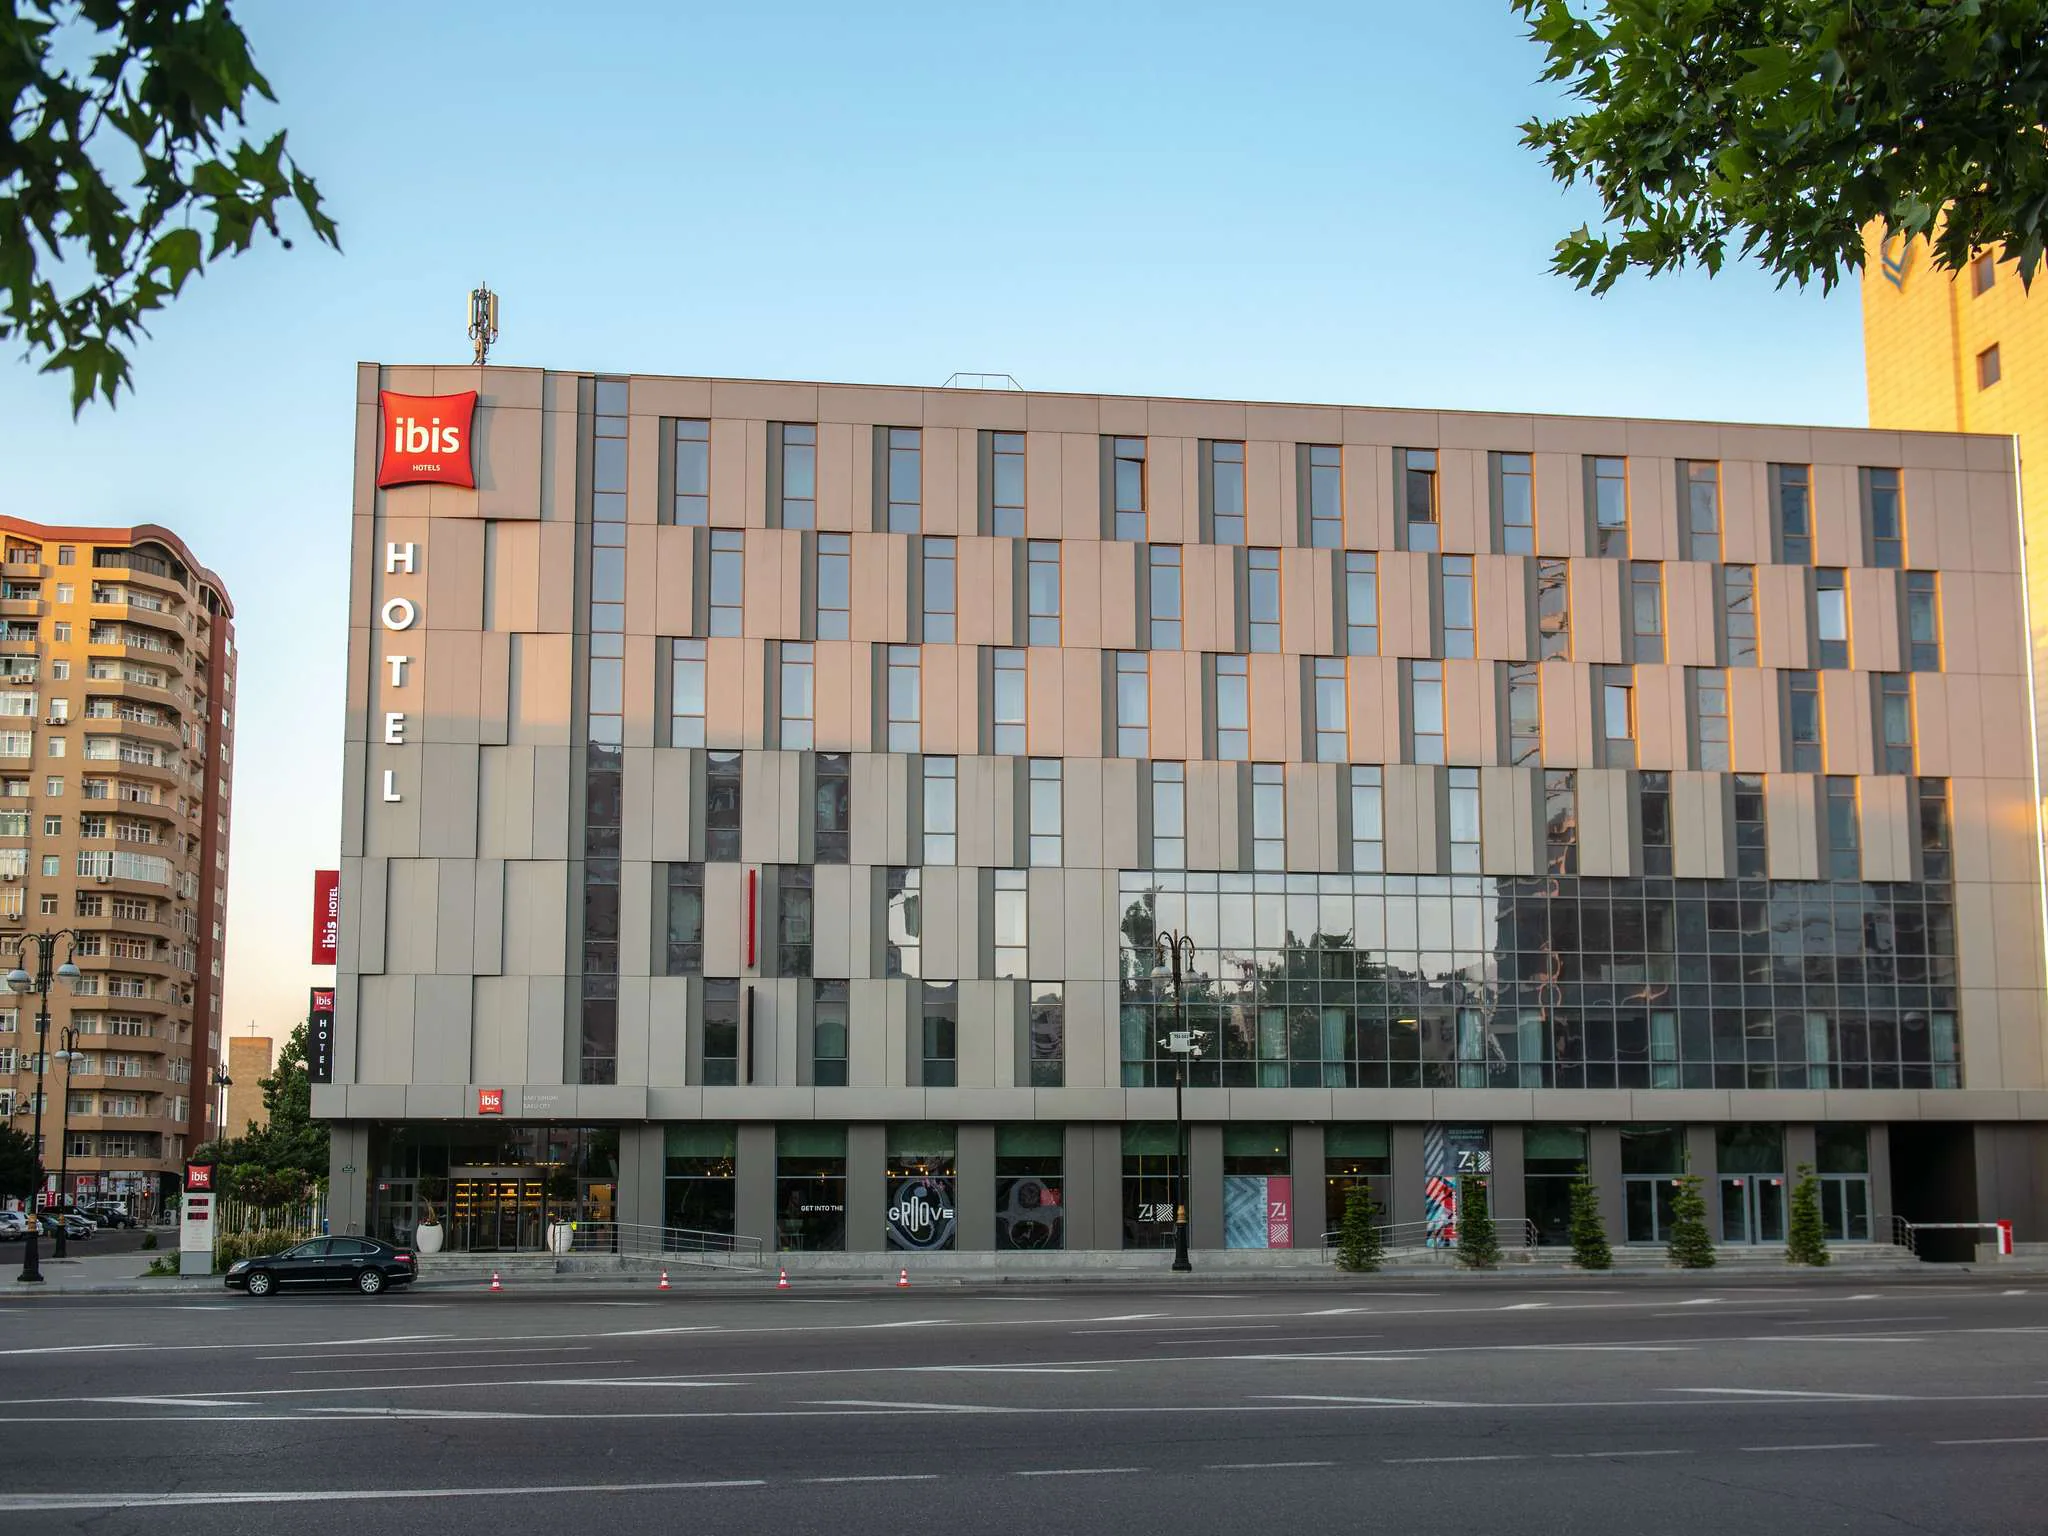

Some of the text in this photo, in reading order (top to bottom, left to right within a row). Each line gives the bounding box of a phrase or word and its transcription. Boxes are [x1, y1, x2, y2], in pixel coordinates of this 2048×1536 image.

[394, 417, 460, 454] ibis
[412, 464, 441, 472] HOTELS
[381, 542, 415, 803] HOTEL
[322, 886, 338, 949] ibis HOTEL
[316, 995, 332, 1006] ibis
[318, 1019, 327, 1076] HOTEL
[481, 1095, 500, 1106] ibis
[191, 1171, 208, 1181] ibis
[888, 1196, 954, 1232] GROOVE
